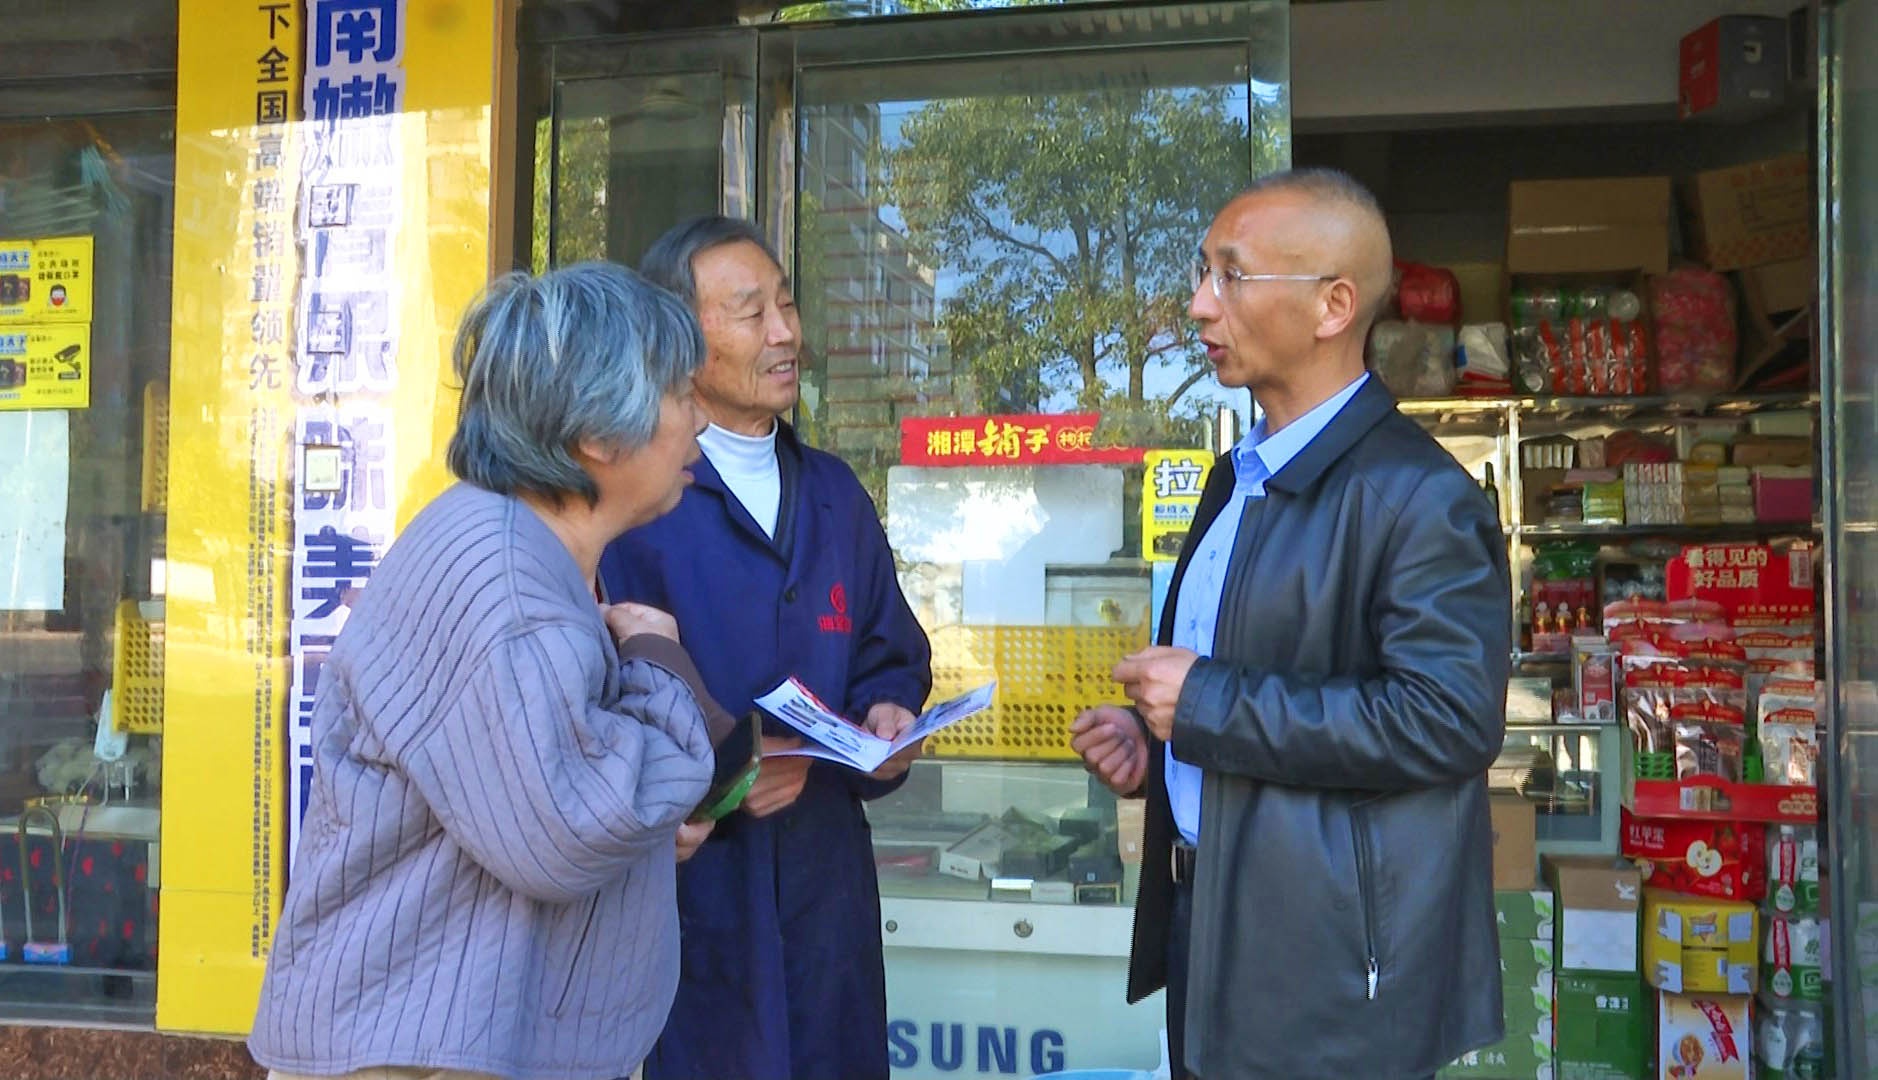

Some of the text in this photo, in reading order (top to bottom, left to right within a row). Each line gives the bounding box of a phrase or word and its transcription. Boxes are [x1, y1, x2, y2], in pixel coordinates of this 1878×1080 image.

[927, 419, 1049, 458] 湘潭铺子
[1155, 457, 1202, 498] 拉
[1685, 548, 1768, 568] 看得见的
[1694, 569, 1759, 589] 好品质
[888, 1018, 1065, 1074] SUNG
